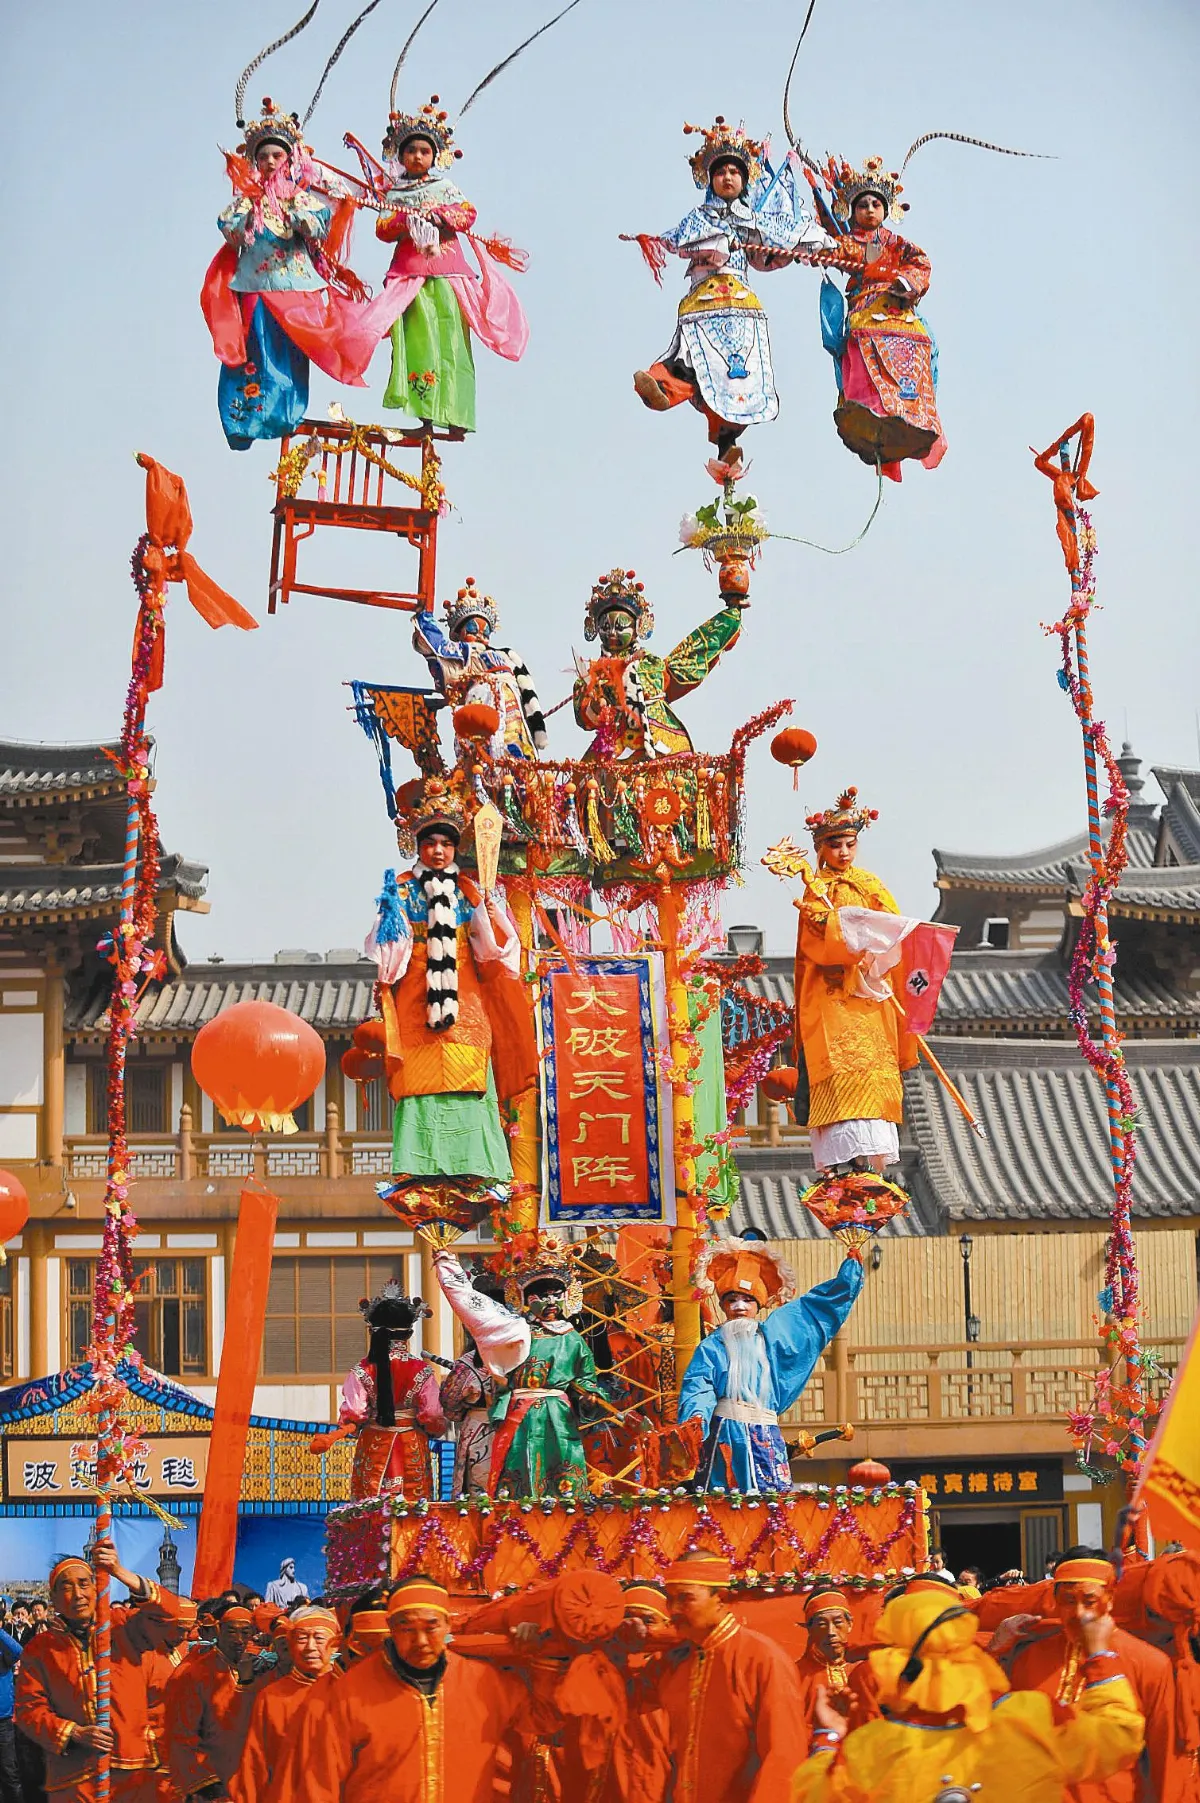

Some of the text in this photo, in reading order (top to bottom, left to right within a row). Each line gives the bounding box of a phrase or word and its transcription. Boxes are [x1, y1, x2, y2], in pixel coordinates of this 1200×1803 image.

[564, 985, 637, 1188] 大破天门阵
[919, 1471, 1038, 1495] 贵宾接待室
